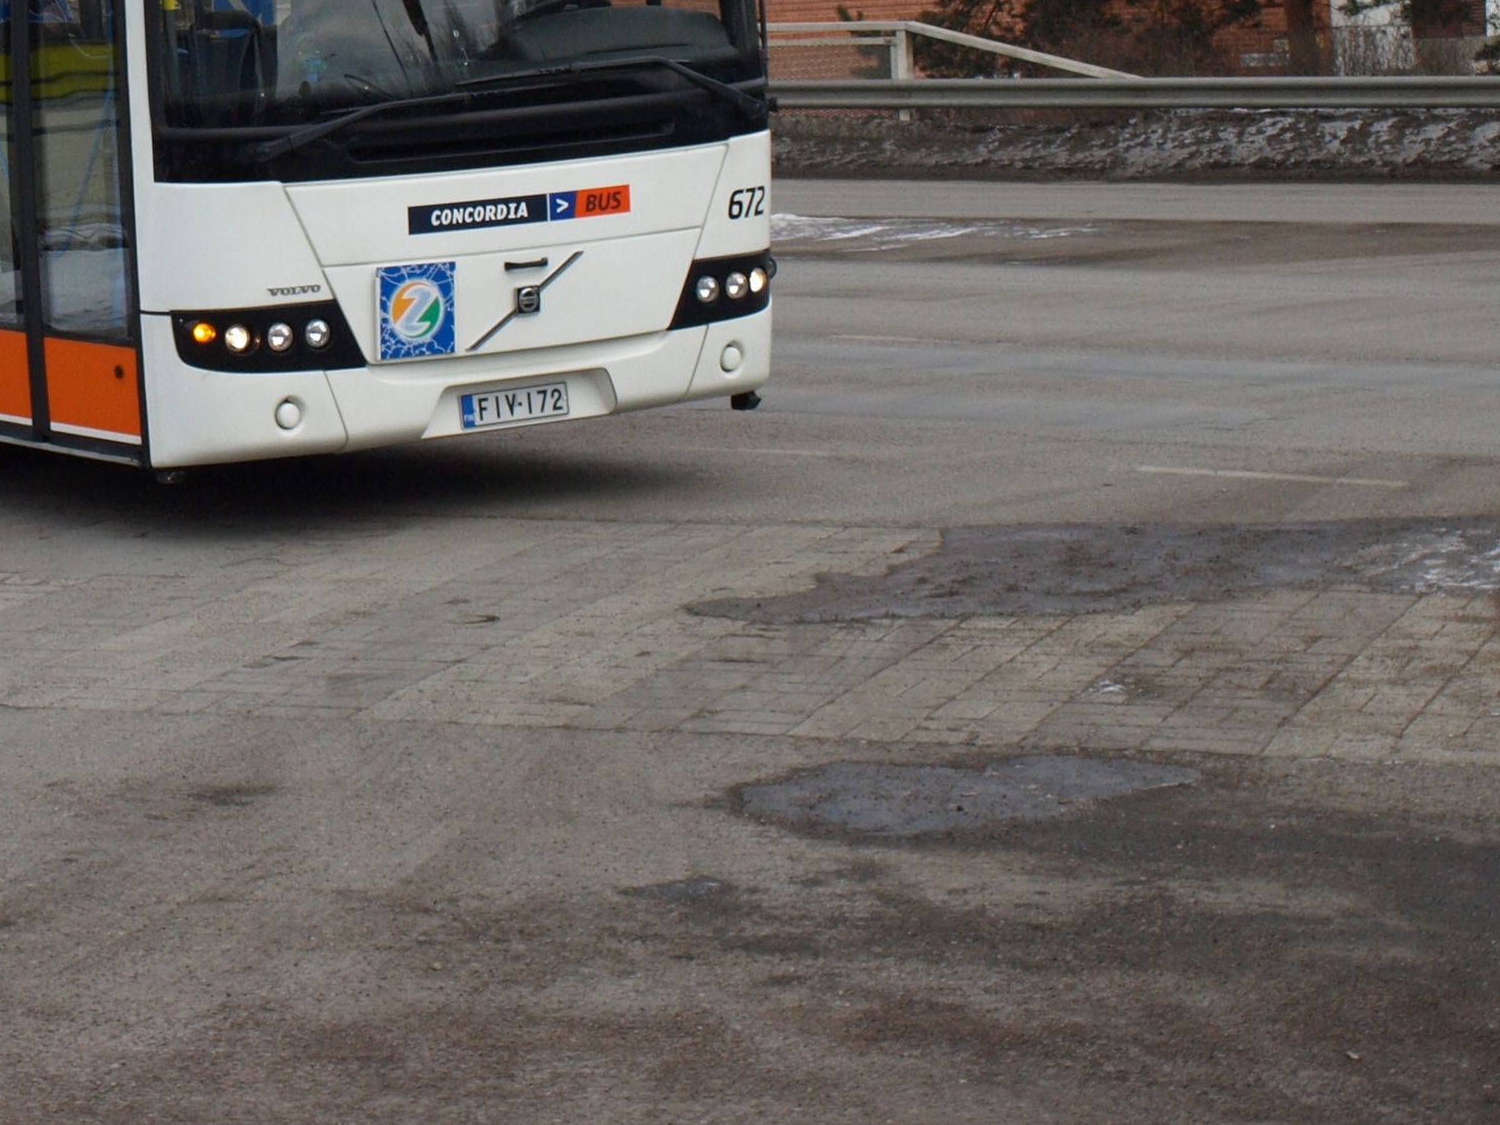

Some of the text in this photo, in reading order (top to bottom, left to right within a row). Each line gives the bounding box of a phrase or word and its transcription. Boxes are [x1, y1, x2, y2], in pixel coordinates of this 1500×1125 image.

[430, 191, 622, 227] CONCORDIA BUS
[728, 185, 765, 220] 672
[268, 284, 321, 297] VOLVO
[478, 388, 564, 421] FIV-172
